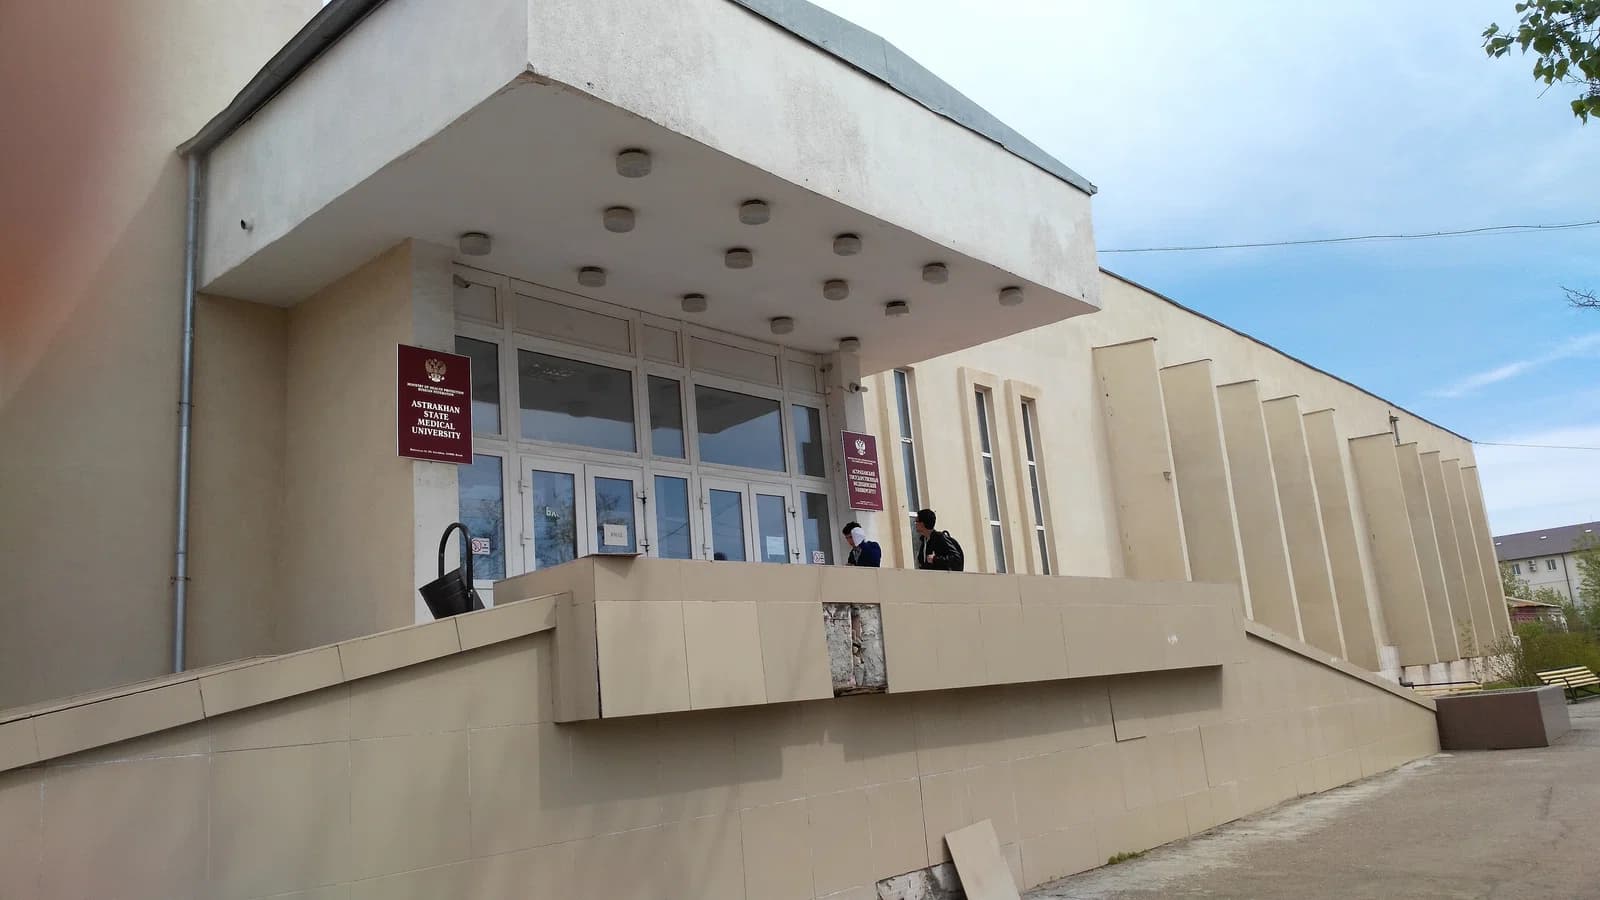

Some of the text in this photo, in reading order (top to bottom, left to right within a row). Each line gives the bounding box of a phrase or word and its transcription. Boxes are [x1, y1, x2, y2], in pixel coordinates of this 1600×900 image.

[411, 400, 460, 414] ASTRAKHAN
[423, 411, 449, 421] STATE
[417, 419, 456, 430] MEDICAL
[412, 427, 461, 440] UNIVERSITY
